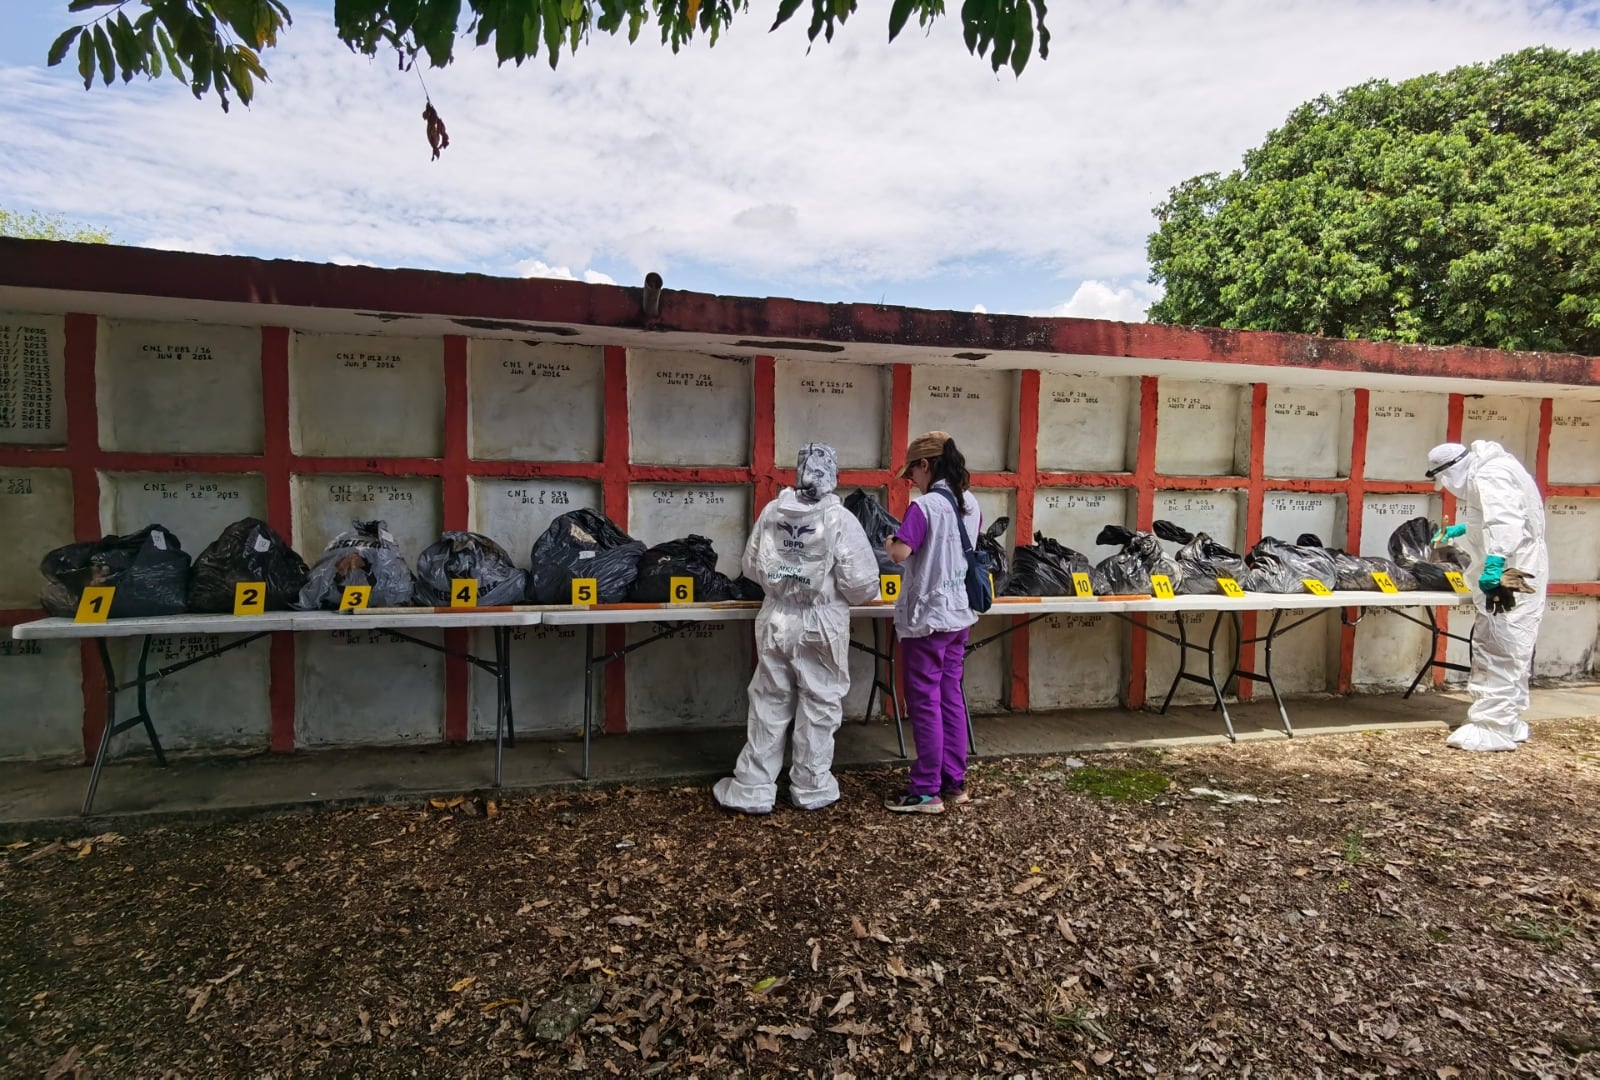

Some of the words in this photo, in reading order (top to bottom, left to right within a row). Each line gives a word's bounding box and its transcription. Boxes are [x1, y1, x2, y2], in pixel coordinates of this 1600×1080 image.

[656, 371, 672, 379] CNI
[143, 482, 168, 492] CNI
[186, 483, 194, 491] P
[330, 485, 352, 493] CNI
[367, 485, 374, 493] P
[162, 491, 179, 500] DIC
[190, 491, 204, 499] 12
[217, 491, 240, 501] 2019
[334, 493, 352, 502] DIC
[362, 493, 375, 502] 12
[388, 493, 412, 501] 2019
[507, 489, 528, 498] CNI
[540, 490, 546, 498] P
[551, 490, 568, 498] 539
[652, 490, 674, 498] CNI
[538, 497, 545, 505] 5
[1045, 495, 1059, 503] CNI
[783, 539, 805, 549] UBPD
[1077, 579, 1090, 593] 10
[1156, 581, 1170, 593] 11
[1310, 582, 1327, 593] 13
[1378, 578, 1393, 588] 14
[1451, 577, 1464, 588] 15
[577, 585, 591, 601] 5
[675, 584, 688, 600] 6
[885, 581, 897, 595] 8
[1224, 583, 1240, 593] 12
[241, 589, 259, 605] 2
[347, 592, 363, 606] 3
[456, 586, 471, 603] 4
[89, 596, 104, 613] 1
